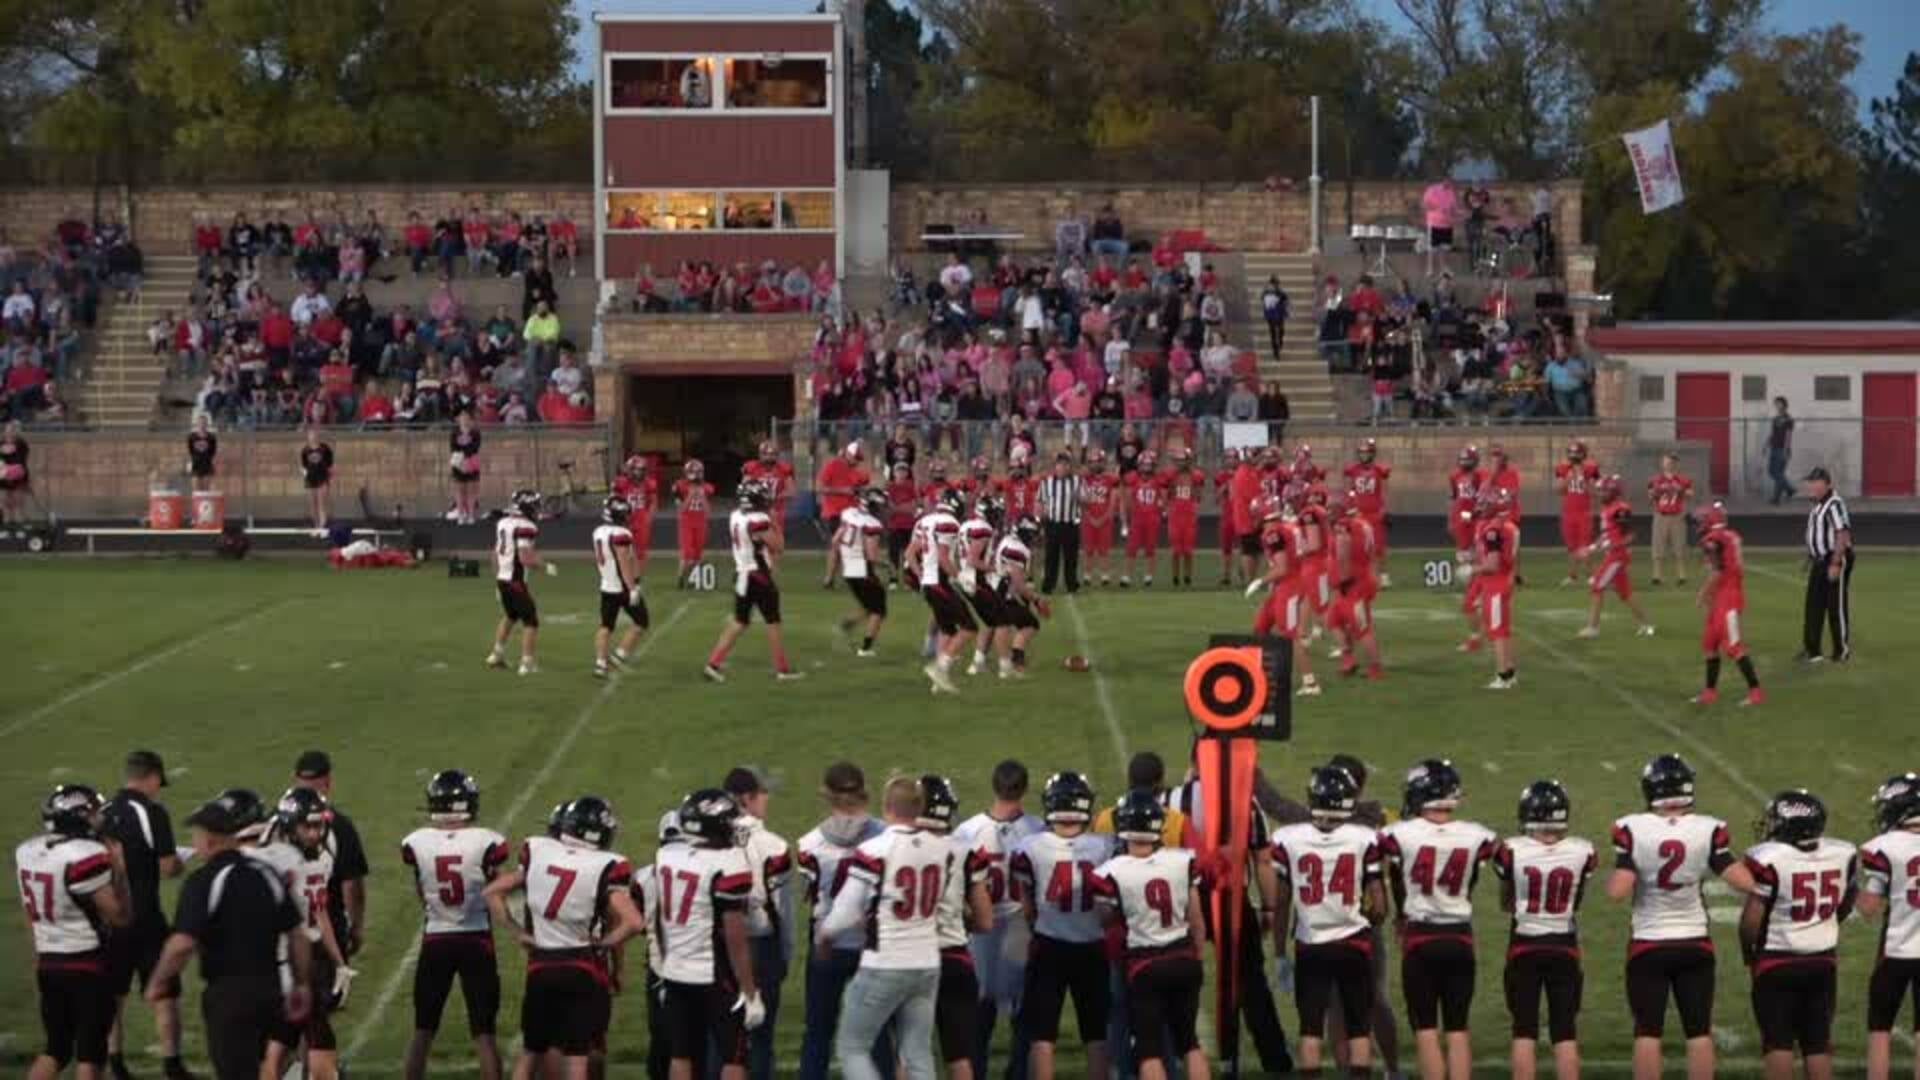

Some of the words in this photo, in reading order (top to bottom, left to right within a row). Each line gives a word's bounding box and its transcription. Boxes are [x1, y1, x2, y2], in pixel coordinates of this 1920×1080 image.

[688, 563, 716, 590] 40
[1424, 561, 1452, 587] 30
[435, 855, 465, 907] 5
[1298, 852, 1358, 907] 34
[1410, 845, 1470, 897] 44
[1522, 865, 1575, 916] 10
[1658, 838, 1687, 892] 2
[19, 868, 56, 924] 57
[546, 864, 578, 921] 7
[659, 864, 699, 926] 17
[893, 864, 941, 922] 30
[1144, 878, 1172, 928] 9
[1790, 868, 1843, 924] 55
